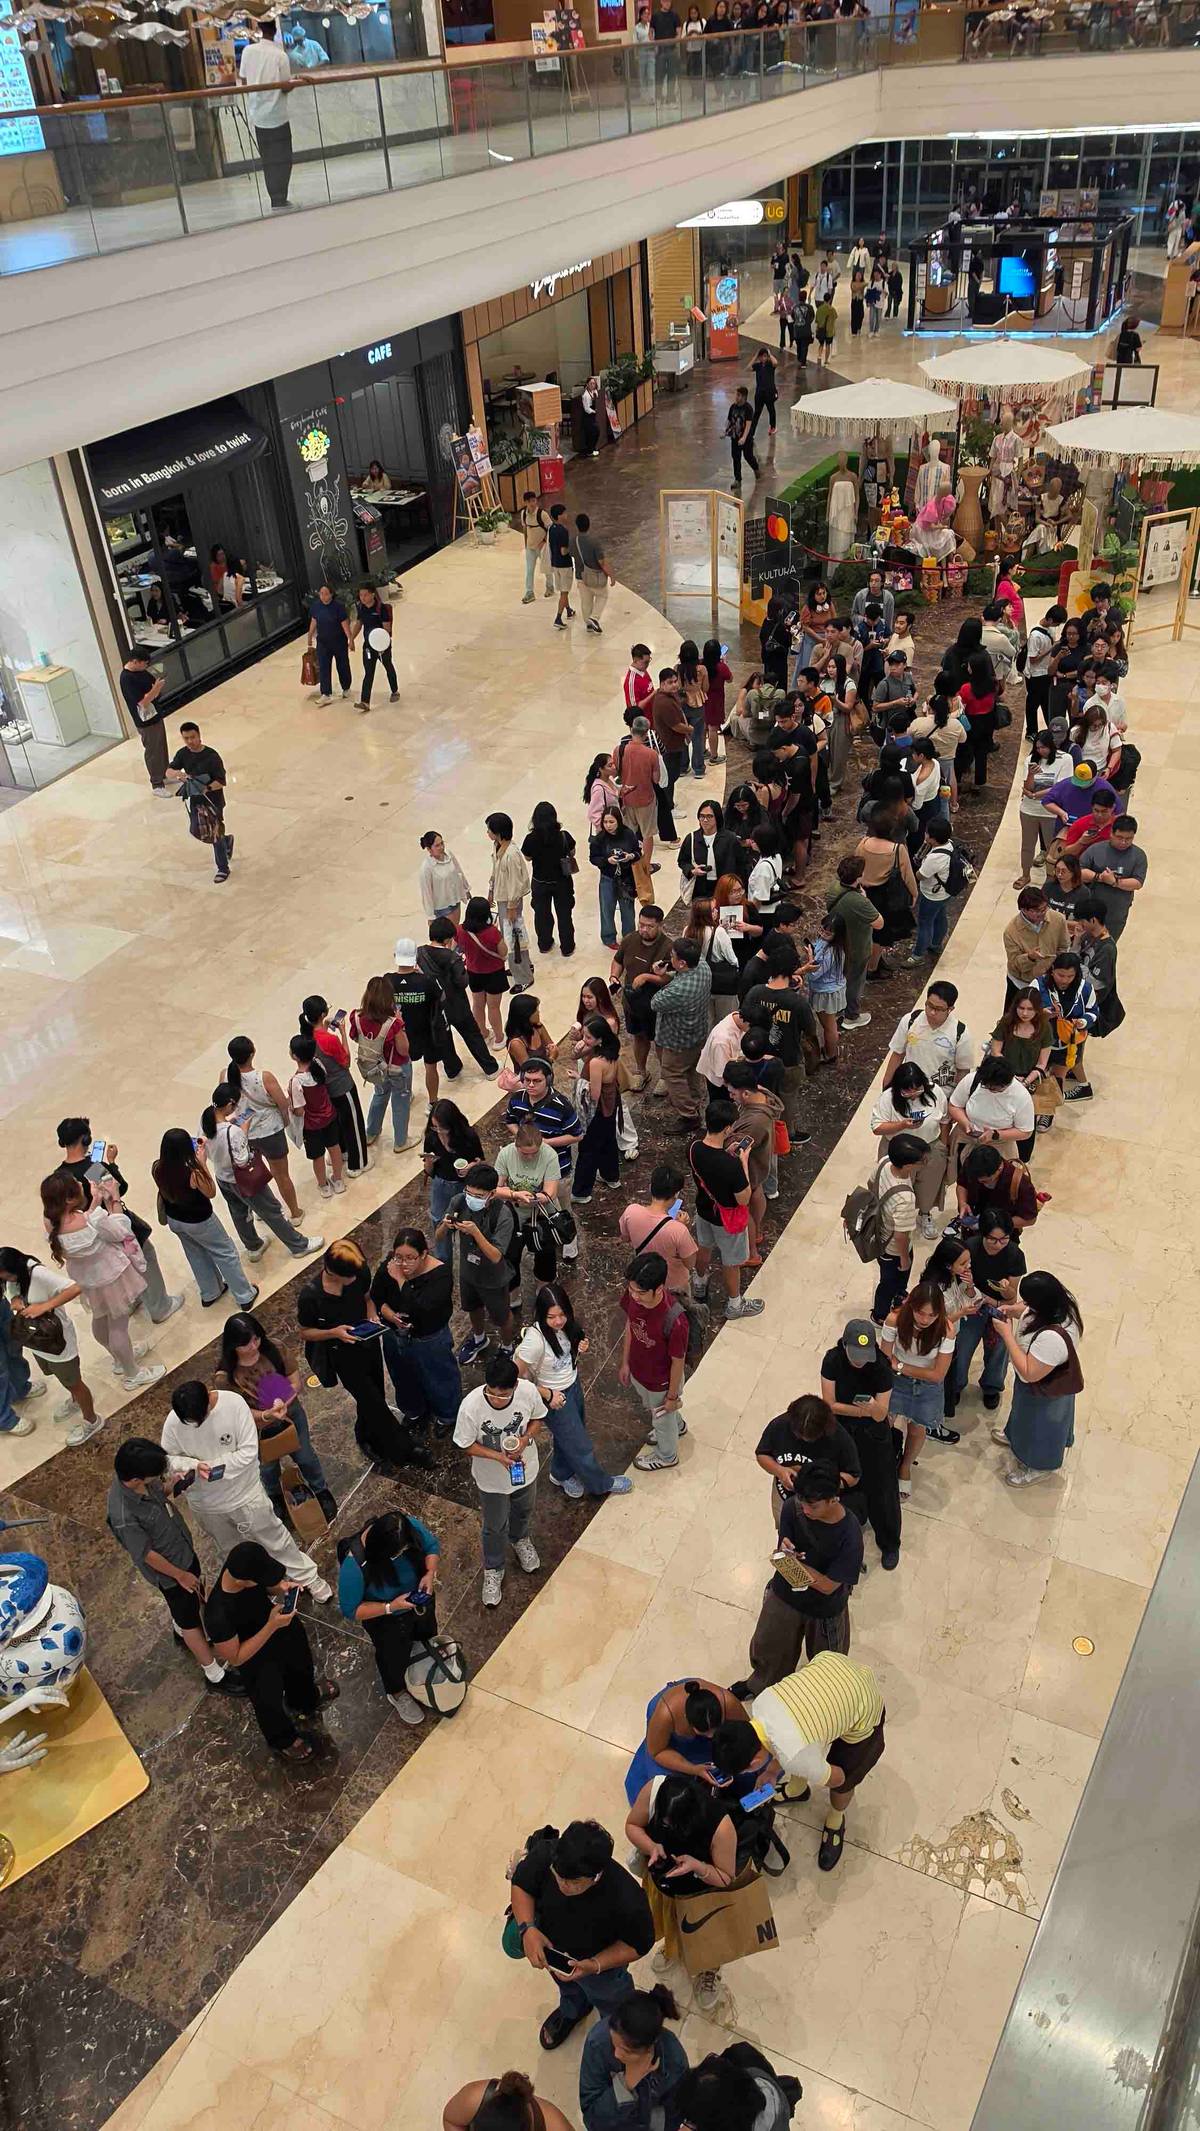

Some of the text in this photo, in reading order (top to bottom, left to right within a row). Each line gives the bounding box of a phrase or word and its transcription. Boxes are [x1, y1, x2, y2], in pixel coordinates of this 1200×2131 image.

[767, 206, 784, 218] UG
[367, 343, 393, 365] CAFE
[101, 483, 131, 499] born
[130, 477, 144, 489] in
[140, 460, 187, 484] Bangkok
[184, 455, 196, 467] &
[193, 447, 217, 464] love
[214, 443, 228, 455] to
[758, 564, 797, 582] KULTURA
[394, 995, 426, 1003] NISHER
